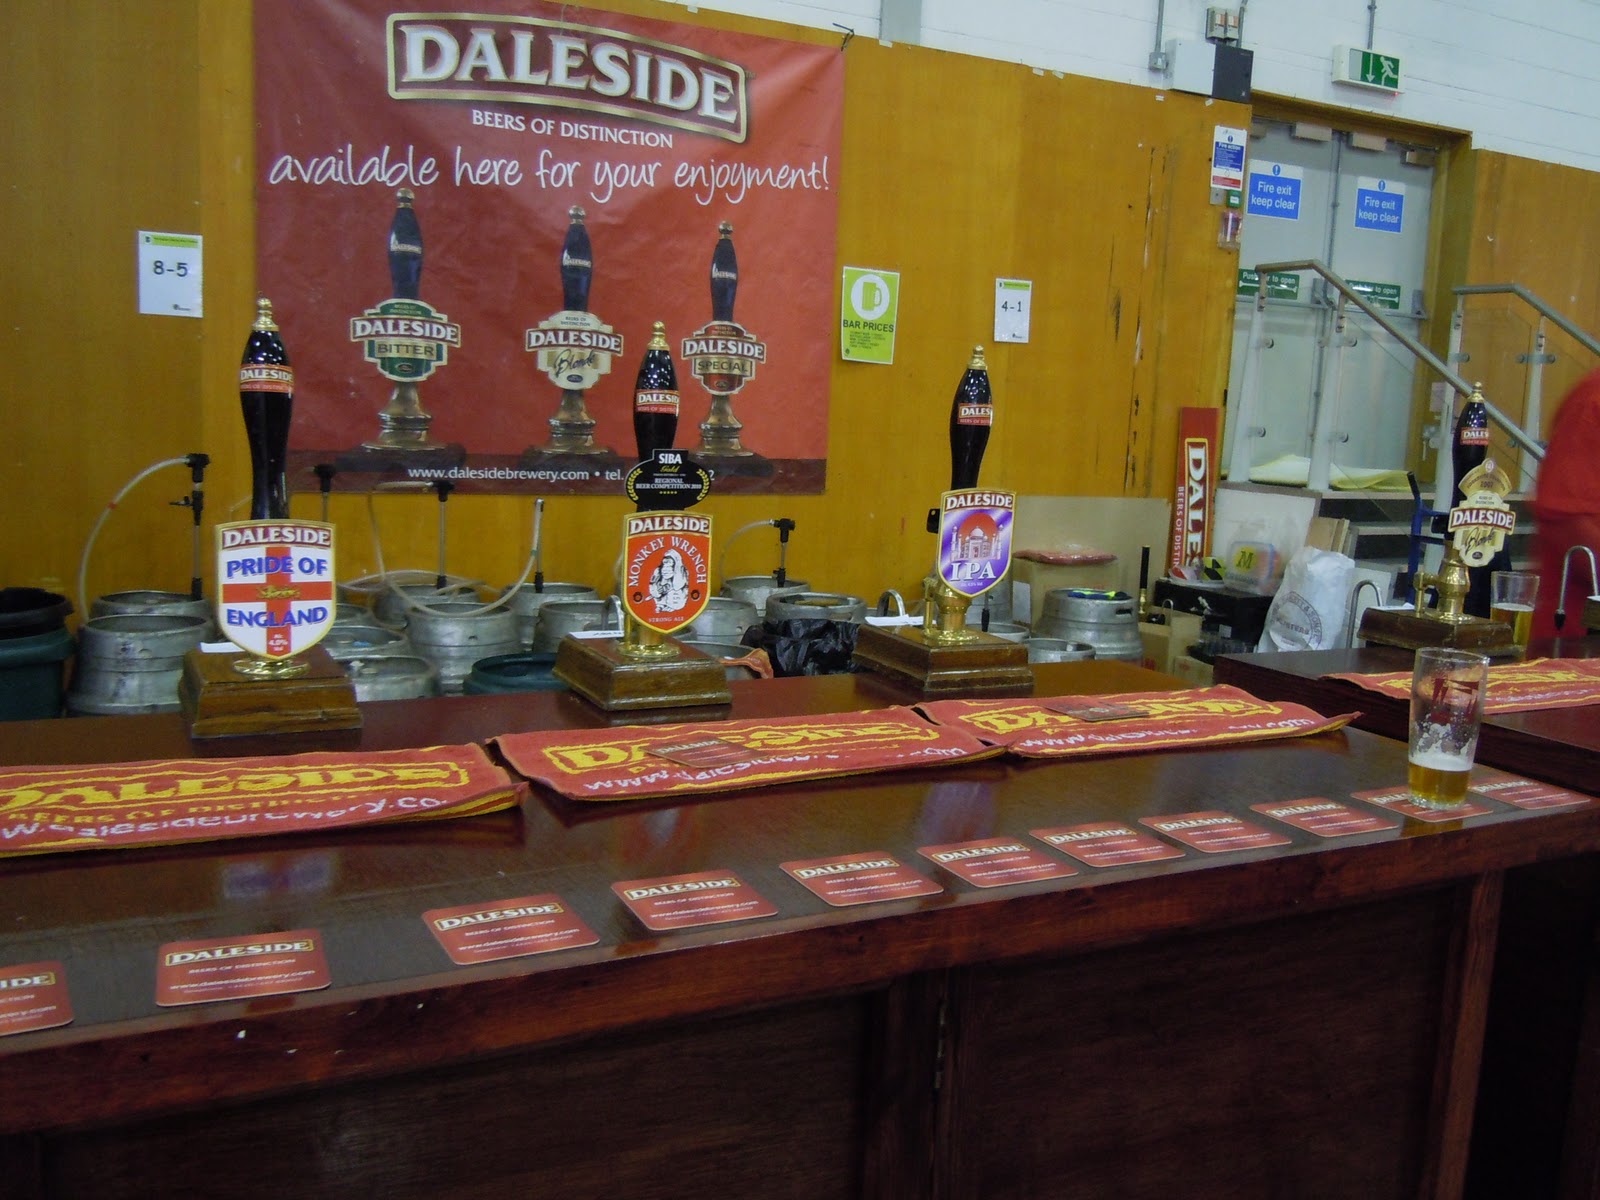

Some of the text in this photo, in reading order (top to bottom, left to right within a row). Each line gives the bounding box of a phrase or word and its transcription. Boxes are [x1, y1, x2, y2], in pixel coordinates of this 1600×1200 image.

[399, 24, 740, 124] DALESIDE
[472, 109, 674, 149] BEERS OF DISTINCTION
[269, 144, 830, 206] available here for your enjoyment!
[1258, 182, 1292, 196] Fire exit
[1251, 195, 1296, 210] keep clear
[1364, 196, 1395, 211] Fire exit
[1358, 210, 1399, 224] keep clear
[153, 260, 188, 277] 8-5
[1280, 277, 1295, 286] open
[1383, 287, 1397, 295] open
[354, 319, 458, 342] DALESIDE
[843, 319, 894, 333] BAR PRICES
[377, 343, 434, 356] BITTER
[529, 331, 620, 351] DALESIDE
[684, 339, 763, 359] DALESIDE
[698, 360, 748, 372] SPECIAL
[658, 453, 682, 464] SIBA
[408, 467, 589, 482] www.dalesidebrewery.com
[605, 469, 624, 481] tel.
[945, 493, 1013, 511] DALESIDE
[1175, 486, 1184, 516] BEERS
[629, 517, 709, 535] DALESIDE
[1175, 518, 1182, 535] OF
[1452, 509, 1513, 529] DALESIDE
[223, 527, 331, 548] DALESIDE
[226, 556, 328, 579] PRIDE OF
[628, 536, 707, 587] MONKEY WRENCH
[951, 561, 996, 581] IPA
[226, 606, 328, 628] ENGLAND
[1050, 828, 1130, 844] DALESIDE
[937, 845, 1025, 862] DALESIDE
[799, 859, 895, 878] DALESIDE
[629, 879, 737, 899] DALESIDE
[440, 904, 560, 930] DALESIDE
[171, 941, 311, 964] DALESIDE
